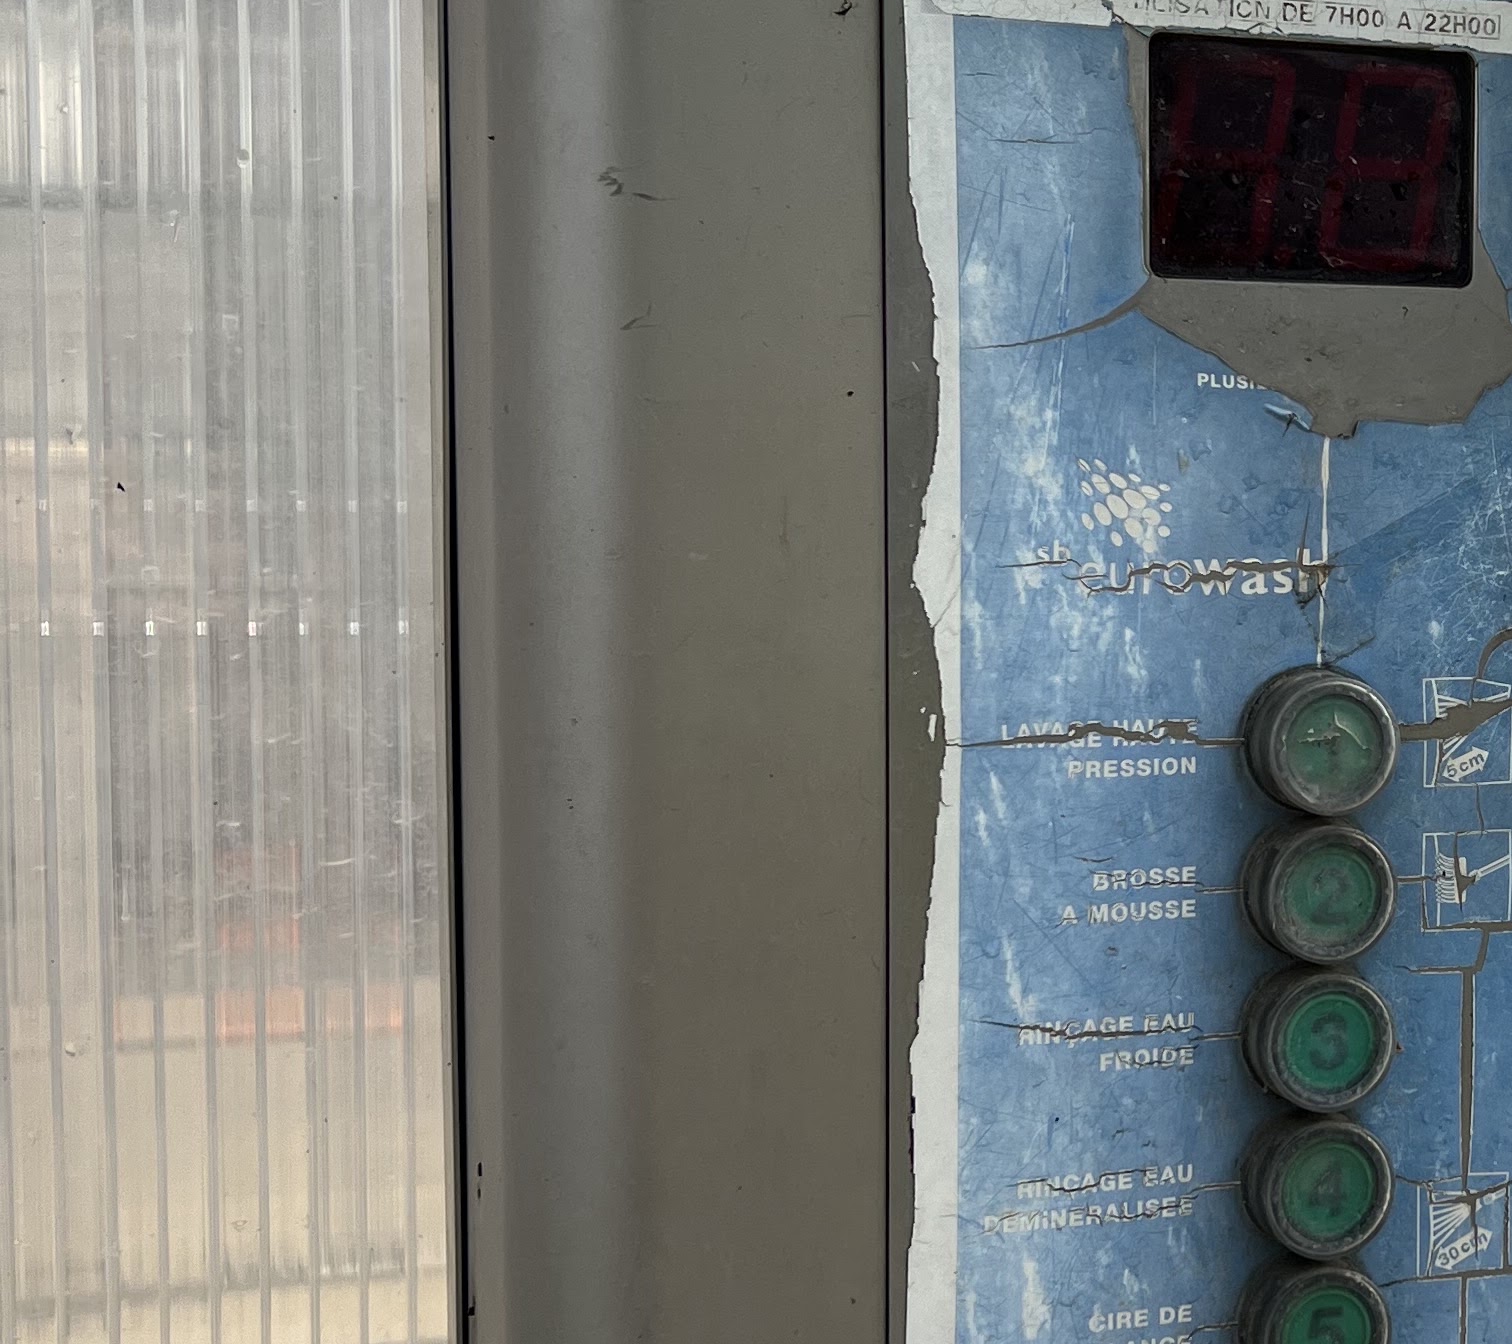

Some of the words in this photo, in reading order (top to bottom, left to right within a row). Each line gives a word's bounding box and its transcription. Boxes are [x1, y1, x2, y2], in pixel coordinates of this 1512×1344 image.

[1281, 1, 1314, 23] DE
[1325, 4, 1384, 28] 7H00
[1396, 9, 1413, 30] A
[1423, 12, 1497, 35] 22H00
[1068, 756, 1197, 779] PRESSION
[1460, 753, 1485, 772] cm
[1093, 866, 1196, 891] BROSSE
[1061, 905, 1078, 926] A
[1088, 899, 1196, 925] MOUSSE
[1144, 1012, 1195, 1036] EAU
[1310, 1012, 1347, 1071] 3
[1100, 1044, 1195, 1072] FROIDE
[1142, 1163, 1193, 1187] EAU
[1309, 1158, 1346, 1218] 4
[1088, 1308, 1149, 1333] CIRE
[1159, 1304, 1193, 1325] DE
